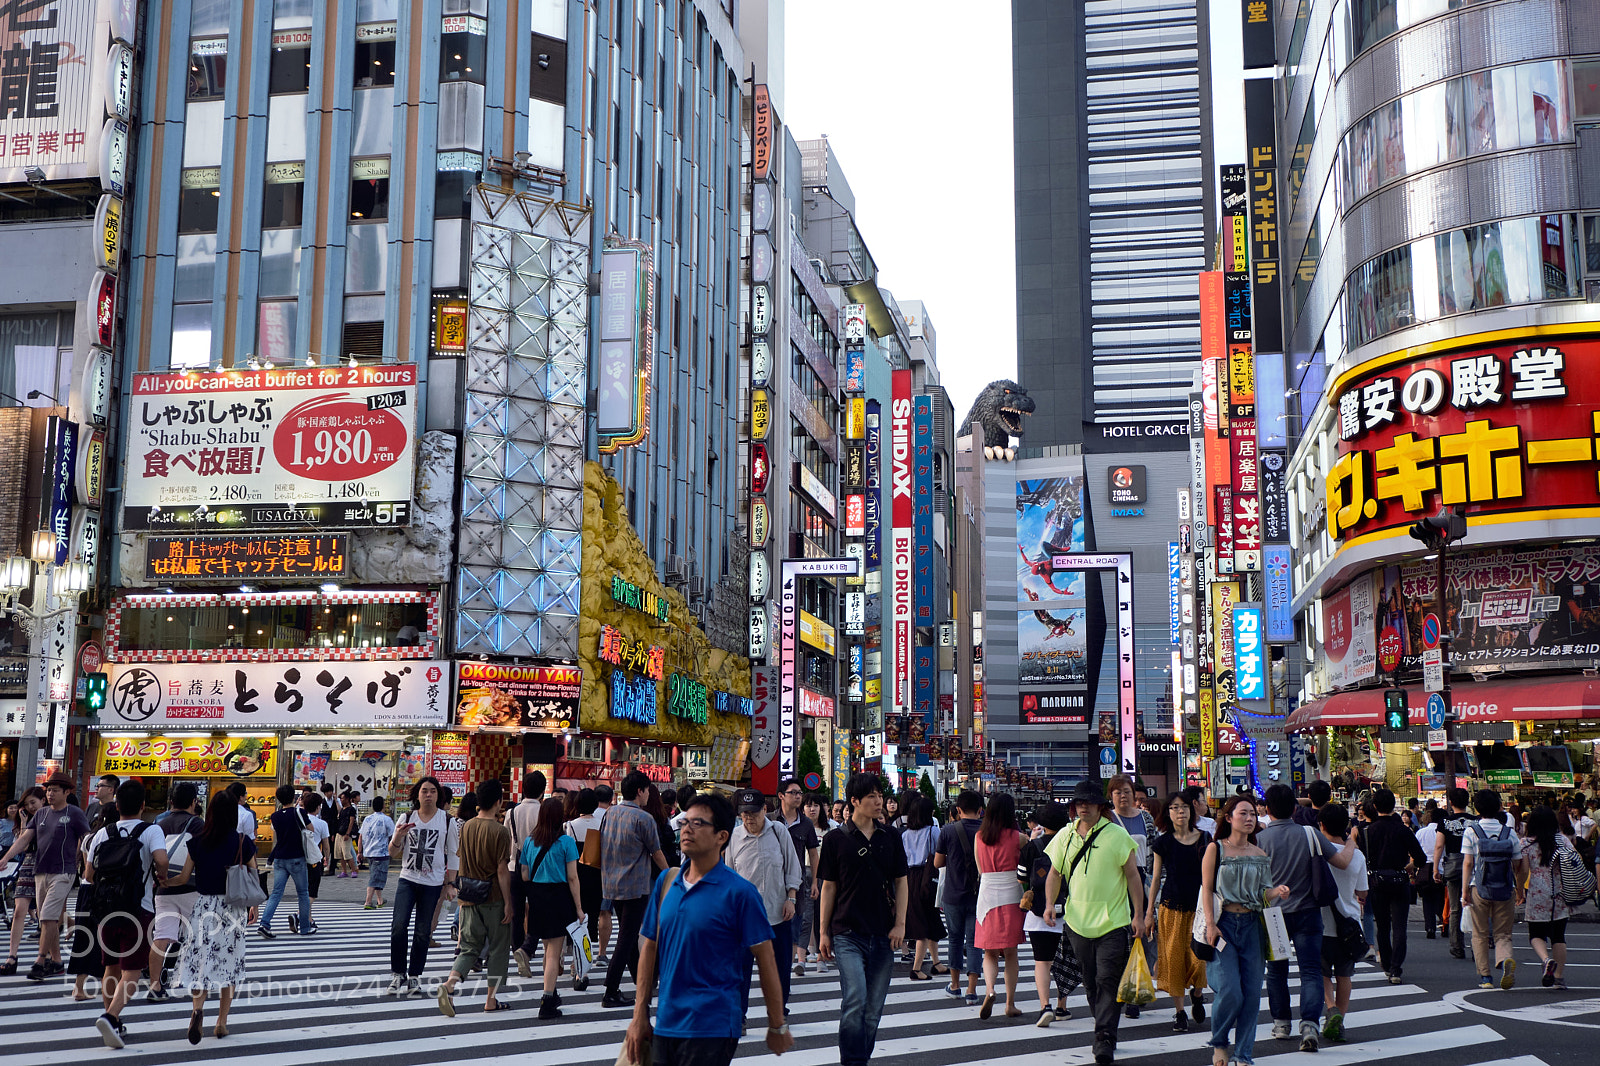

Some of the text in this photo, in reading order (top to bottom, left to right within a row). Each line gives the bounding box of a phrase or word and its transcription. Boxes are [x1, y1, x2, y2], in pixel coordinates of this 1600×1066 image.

[354, 160, 376, 168] Shabu
[366, 167, 388, 175] Shabu
[1252, 146, 1278, 285] ドン・キホーテ
[105, 216, 119, 253] 虎の子
[1234, 218, 1245, 260] Garam
[607, 270, 628, 334] 居酒屋
[444, 315, 462, 342] 虎の子
[1235, 331, 1250, 339] 7F
[138, 368, 412, 393] All-you-can-eat buffet for 2 hours
[369, 391, 404, 410] 120分
[1339, 347, 1568, 441] 驚安の殿堂
[142, 397, 274, 426] しゃぶしゃぶ
[754, 404, 768, 428] 虎の子
[1237, 405, 1254, 416] 6F
[1103, 427, 1142, 438] HOTEL
[288, 428, 395, 471] 1,980 yen
[892, 398, 911, 499] SHIDAX
[89, 443, 101, 497] お好み焼き
[143, 446, 266, 478] 食べ放題!
[1238, 440, 1257, 492] 居楽屋
[1326, 410, 1600, 540] ドン・キホー
[209, 484, 263, 502] 2,480 yen
[326, 481, 381, 499] 1,480 yen
[255, 510, 316, 522] USAGIYA
[343, 503, 407, 525] 当ビル 5F
[755, 505, 763, 542] お好み焼き
[1111, 508, 1145, 517] IMAX
[866, 498, 880, 552] SHINJUKU
[1170, 545, 1180, 574] 747
[1476, 556, 1495, 564] real
[1496, 554, 1515, 564] spy
[1516, 549, 1574, 562] experience
[895, 537, 908, 616] BIC DRUG
[1271, 579, 1280, 611] STAGE
[1279, 579, 1288, 606] IDOL
[898, 622, 906, 637] BIC
[1273, 619, 1288, 630] 5F
[1022, 650, 1084, 660] スパイダーマン
[1237, 611, 1261, 695] カラオケ
[1383, 655, 1396, 665] 追加
[461, 664, 582, 683] OKONOMI YAKI
[782, 592, 794, 754] GODZILLA ROAD
[1119, 601, 1133, 742] ゴジラロード
[117, 669, 156, 718] 虎
[168, 679, 224, 697] 旨蕎麦
[233, 667, 412, 715] とらそば
[460, 680, 509, 688] All-You-Can-Eat
[169, 698, 222, 706] TORA SOBA
[671, 673, 707, 725] 24時間
[754, 671, 768, 730] トラノコ
[1041, 695, 1084, 708] MARUHAN
[166, 707, 200, 719] かけそば
[1407, 706, 1425, 718] on
[1430, 702, 1438, 725] P
[106, 740, 231, 757] とんこつラーメン
[1140, 743, 1159, 752] OHO
[1219, 729, 1236, 744] 2F
[1266, 740, 1281, 781] カラオ
